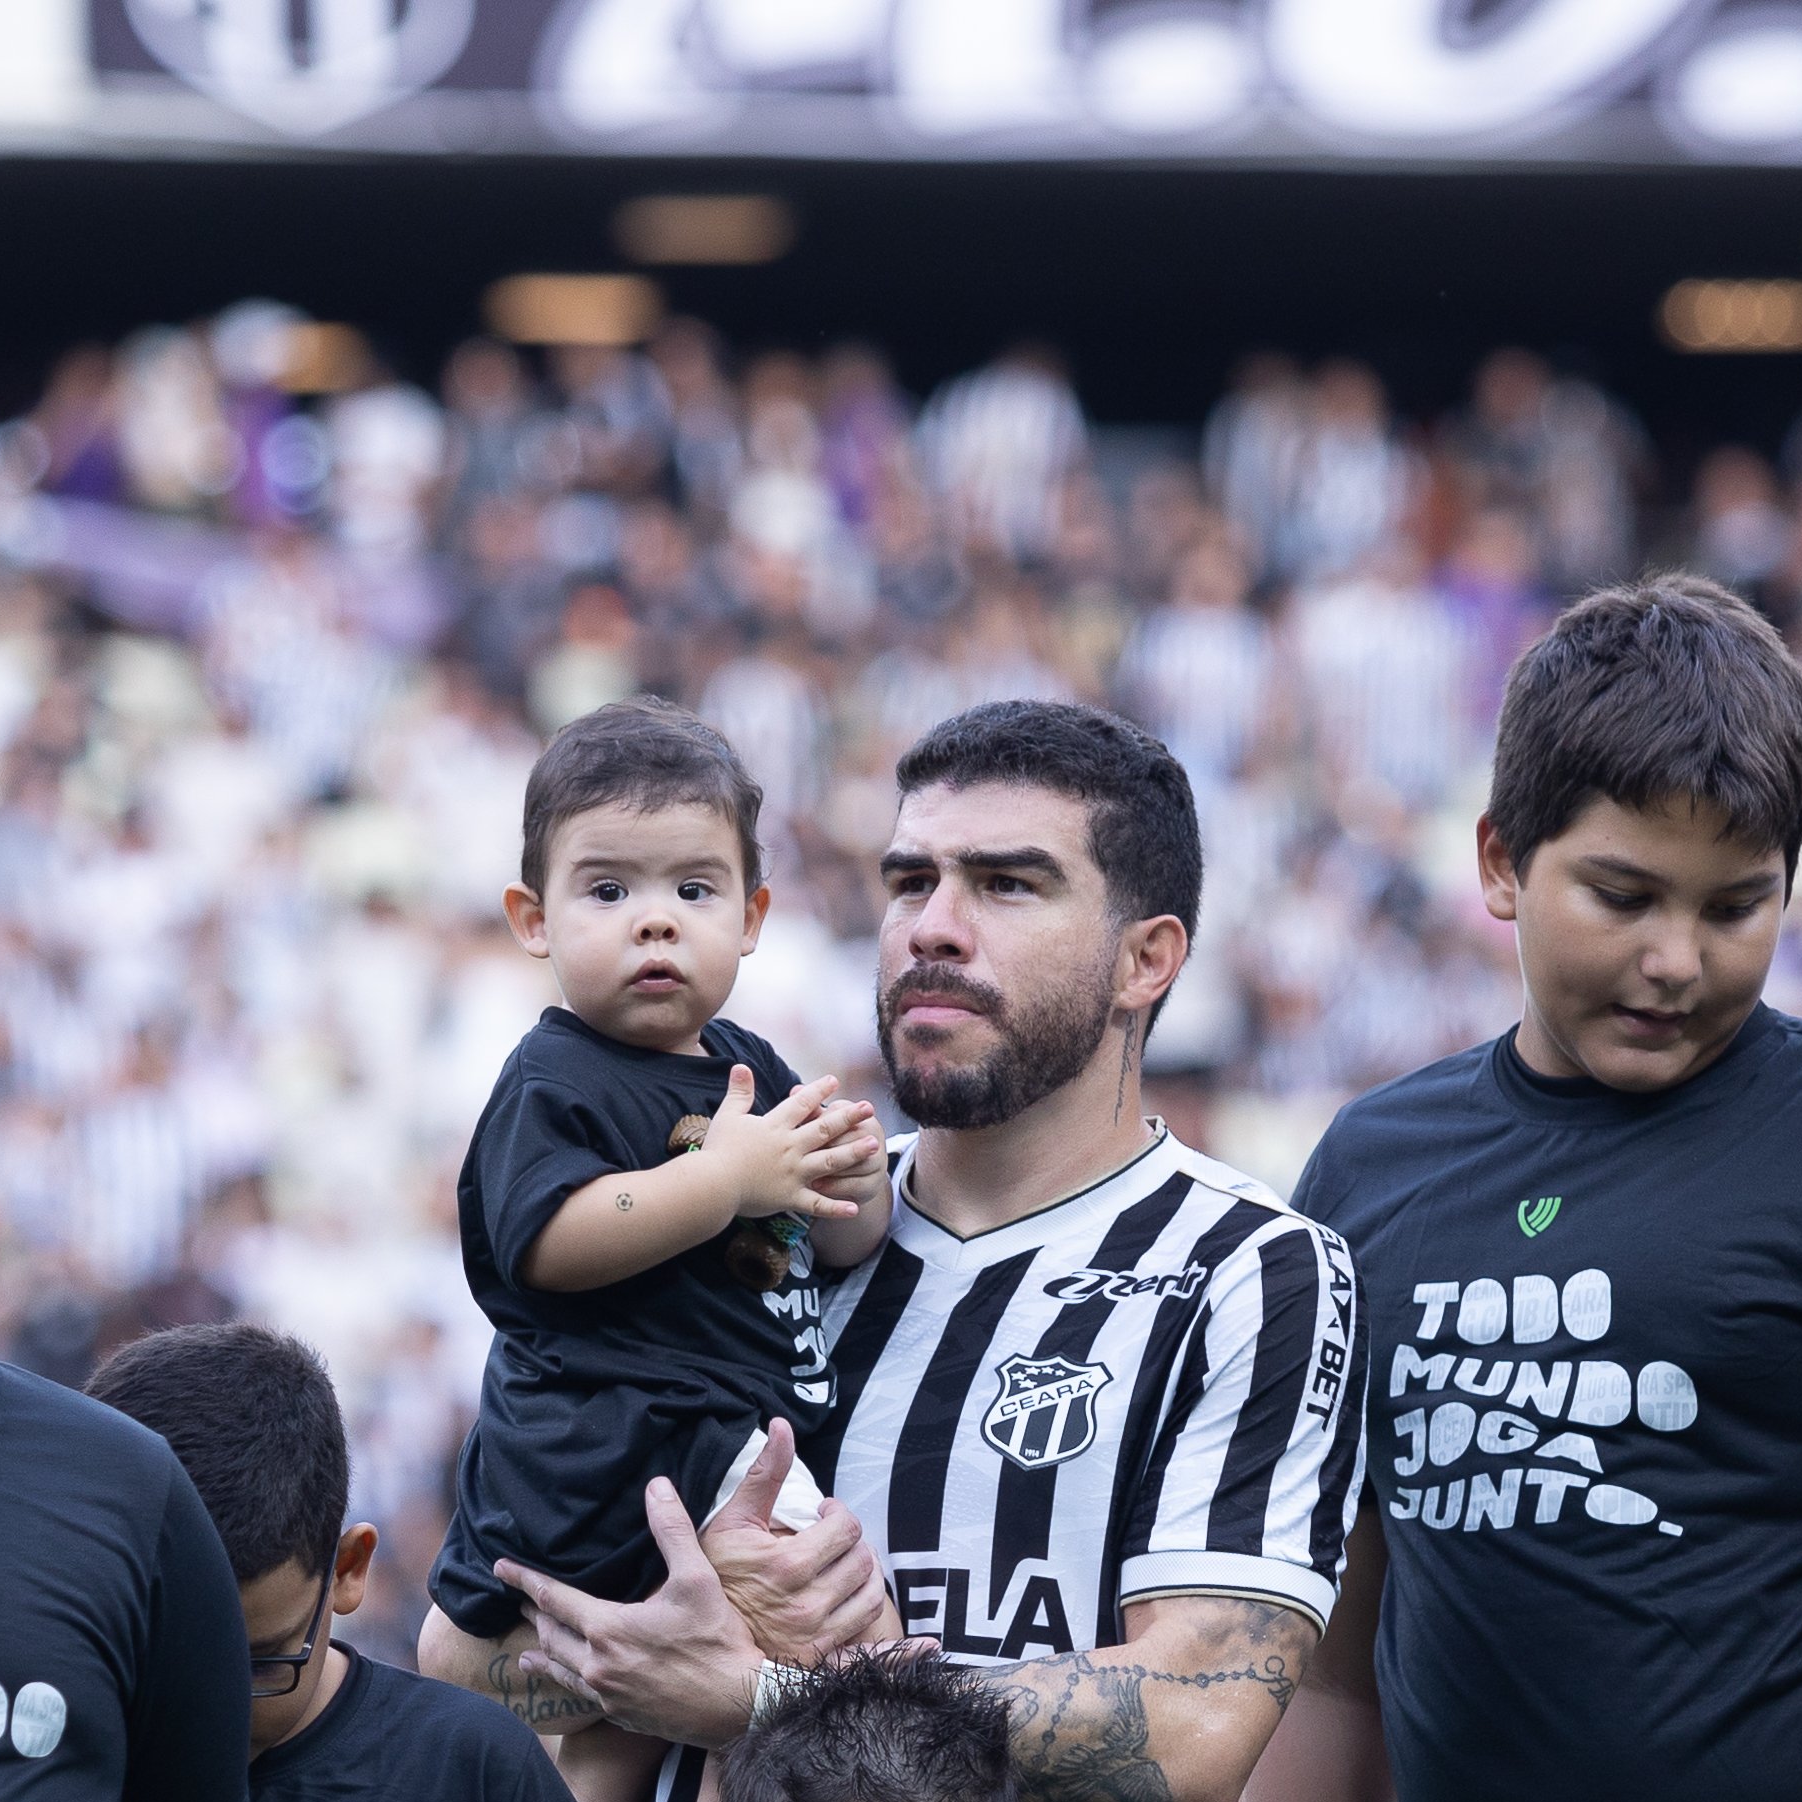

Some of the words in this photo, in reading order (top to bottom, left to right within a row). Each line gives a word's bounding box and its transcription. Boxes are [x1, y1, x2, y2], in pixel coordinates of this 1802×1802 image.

[1413, 1268, 1612, 1346] TODO
[1000, 1374, 1095, 1417] CEARÁ
[1306, 1338, 1347, 1433] BET
[1389, 1343, 1699, 1432] MUNDO
[1393, 1402, 1604, 1477] JOGA
